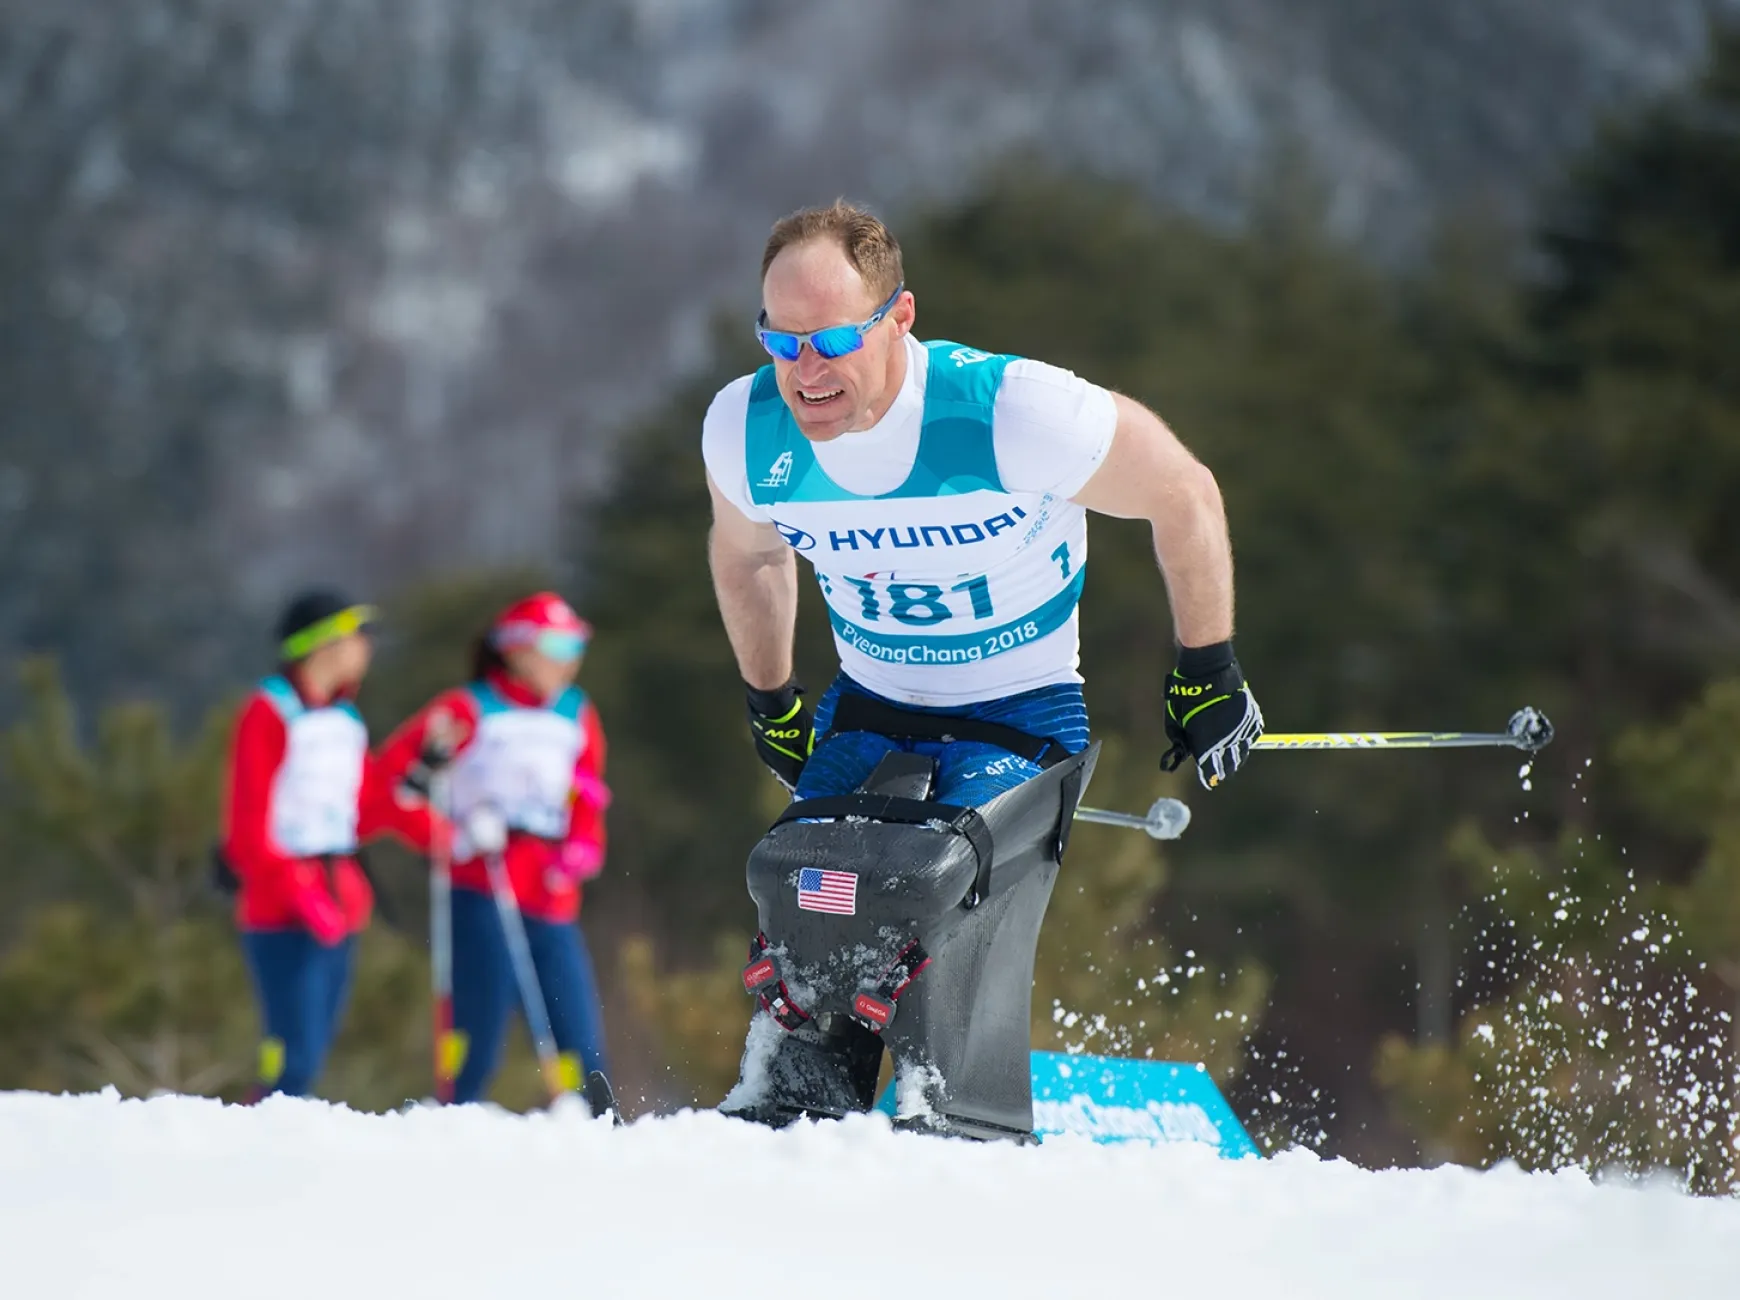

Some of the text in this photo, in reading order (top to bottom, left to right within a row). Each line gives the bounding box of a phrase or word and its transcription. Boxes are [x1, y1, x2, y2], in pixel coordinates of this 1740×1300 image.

[829, 506, 1027, 551] HYUNDAI
[843, 574, 994, 627] 181
[842, 621, 1039, 664] PyeongChang 2018
